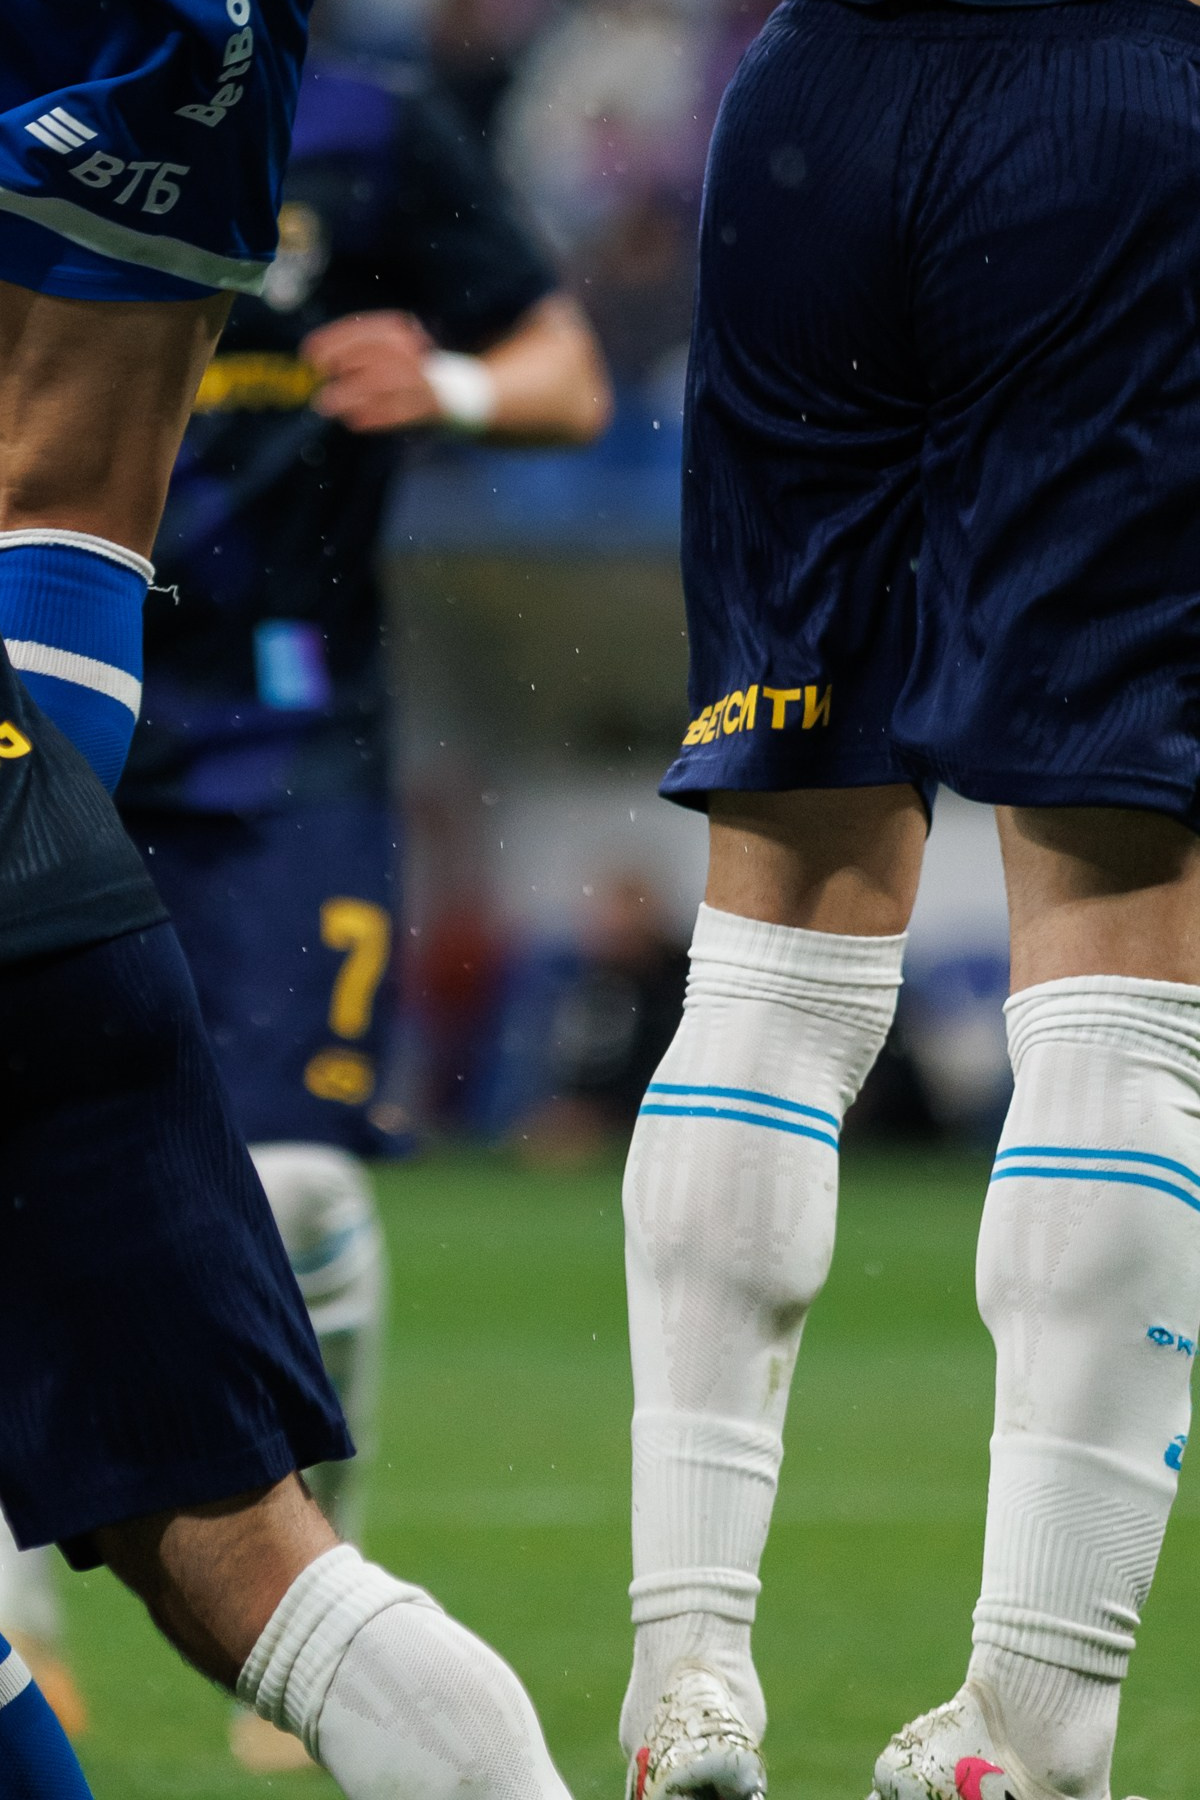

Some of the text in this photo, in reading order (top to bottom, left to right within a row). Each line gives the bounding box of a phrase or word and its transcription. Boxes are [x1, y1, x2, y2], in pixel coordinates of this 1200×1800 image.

[69, 150, 191, 216] ВТБ
[682, 684, 833, 745] БЕТСИТИ
[319, 896, 392, 1040] 7
